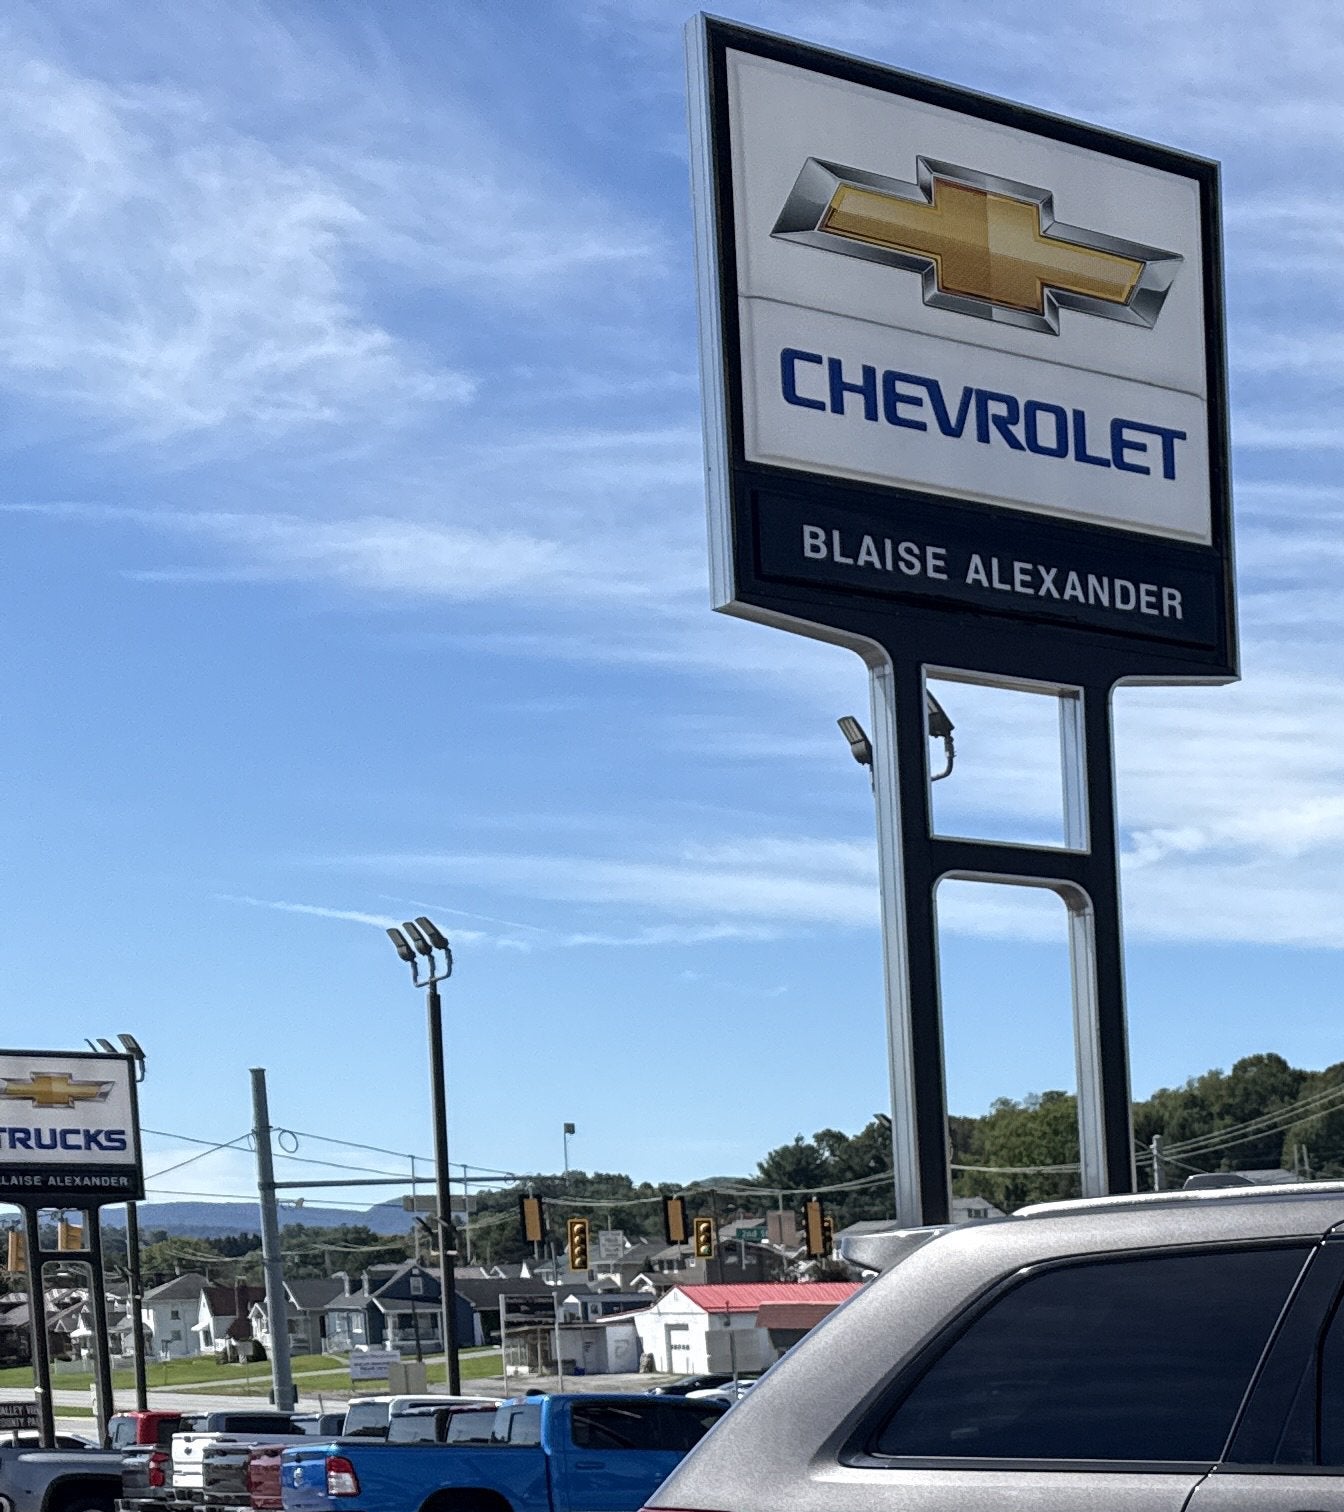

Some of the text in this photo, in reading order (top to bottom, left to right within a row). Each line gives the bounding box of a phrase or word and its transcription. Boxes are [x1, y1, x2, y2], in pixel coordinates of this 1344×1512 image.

[780, 346, 1187, 480] CHEVROLET
[802, 524, 1183, 620] BLAISE ALEXANDER
[0, 1175, 129, 1187] LAISE ALEXANDER
